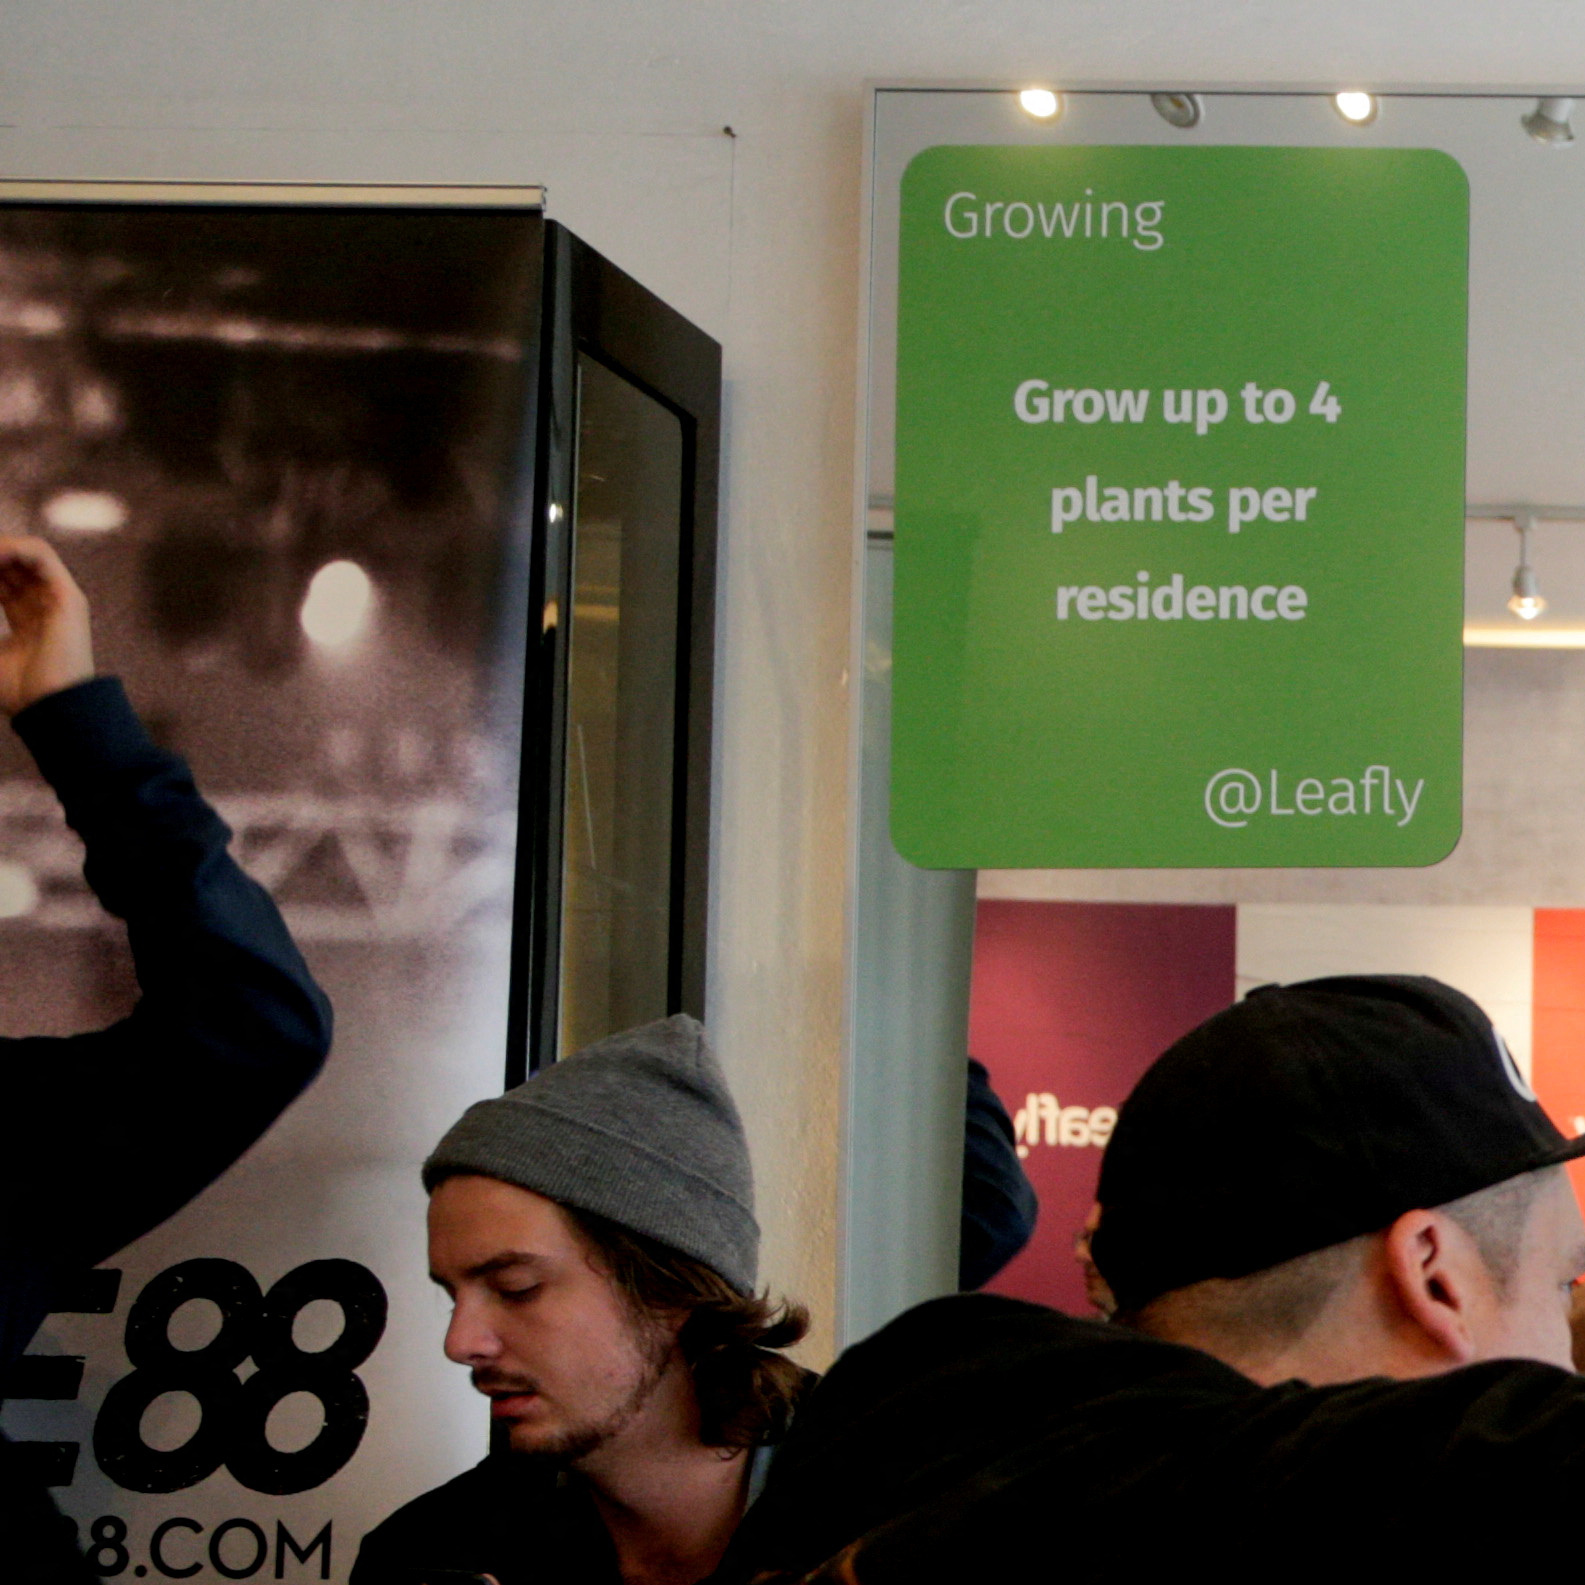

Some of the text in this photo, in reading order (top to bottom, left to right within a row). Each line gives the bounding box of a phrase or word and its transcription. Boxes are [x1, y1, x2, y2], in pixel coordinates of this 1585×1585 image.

[944, 190, 1165, 250] Growing
[1014, 379, 1342, 435] Grow up to 4
[1051, 475, 1317, 534] plants per
[1056, 570, 1308, 622] residence
[1203, 765, 1424, 828] @Leafly
[62, 1514, 333, 1580] 8.COM
